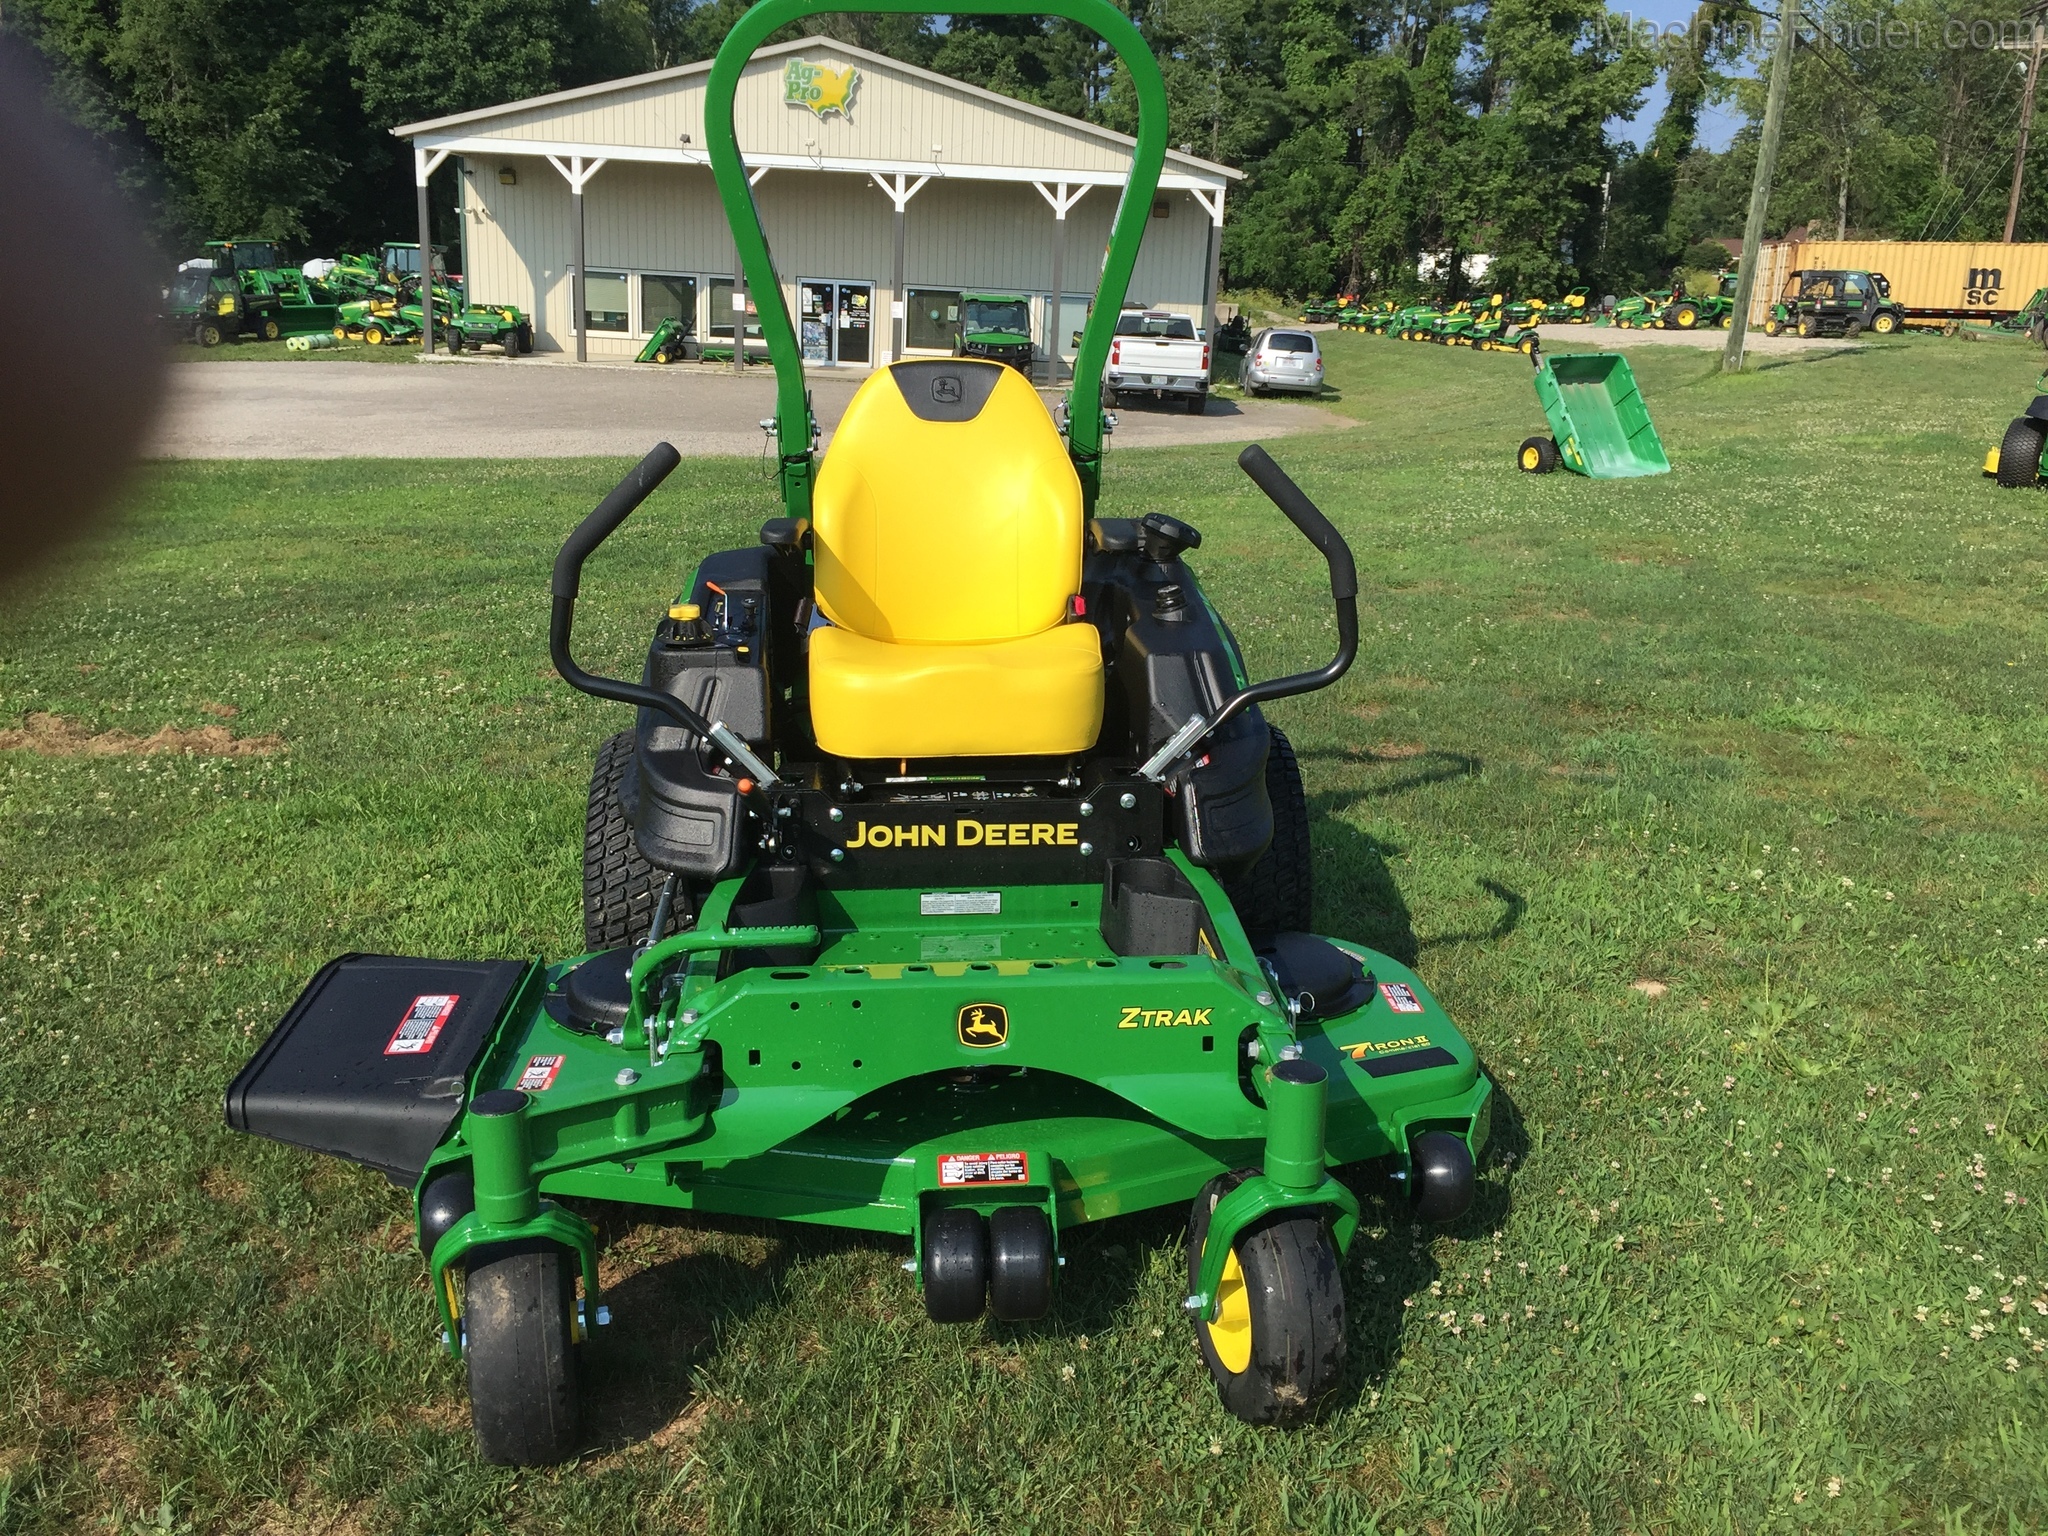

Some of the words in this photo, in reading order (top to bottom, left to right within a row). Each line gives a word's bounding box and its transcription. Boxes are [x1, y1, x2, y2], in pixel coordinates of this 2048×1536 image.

[786, 60, 822, 86] Ag-
[786, 80, 822, 101] Pro
[846, 821, 946, 848] JOHN
[956, 819, 1079, 847] DEERE
[1118, 1006, 1215, 1029] ZTRAK
